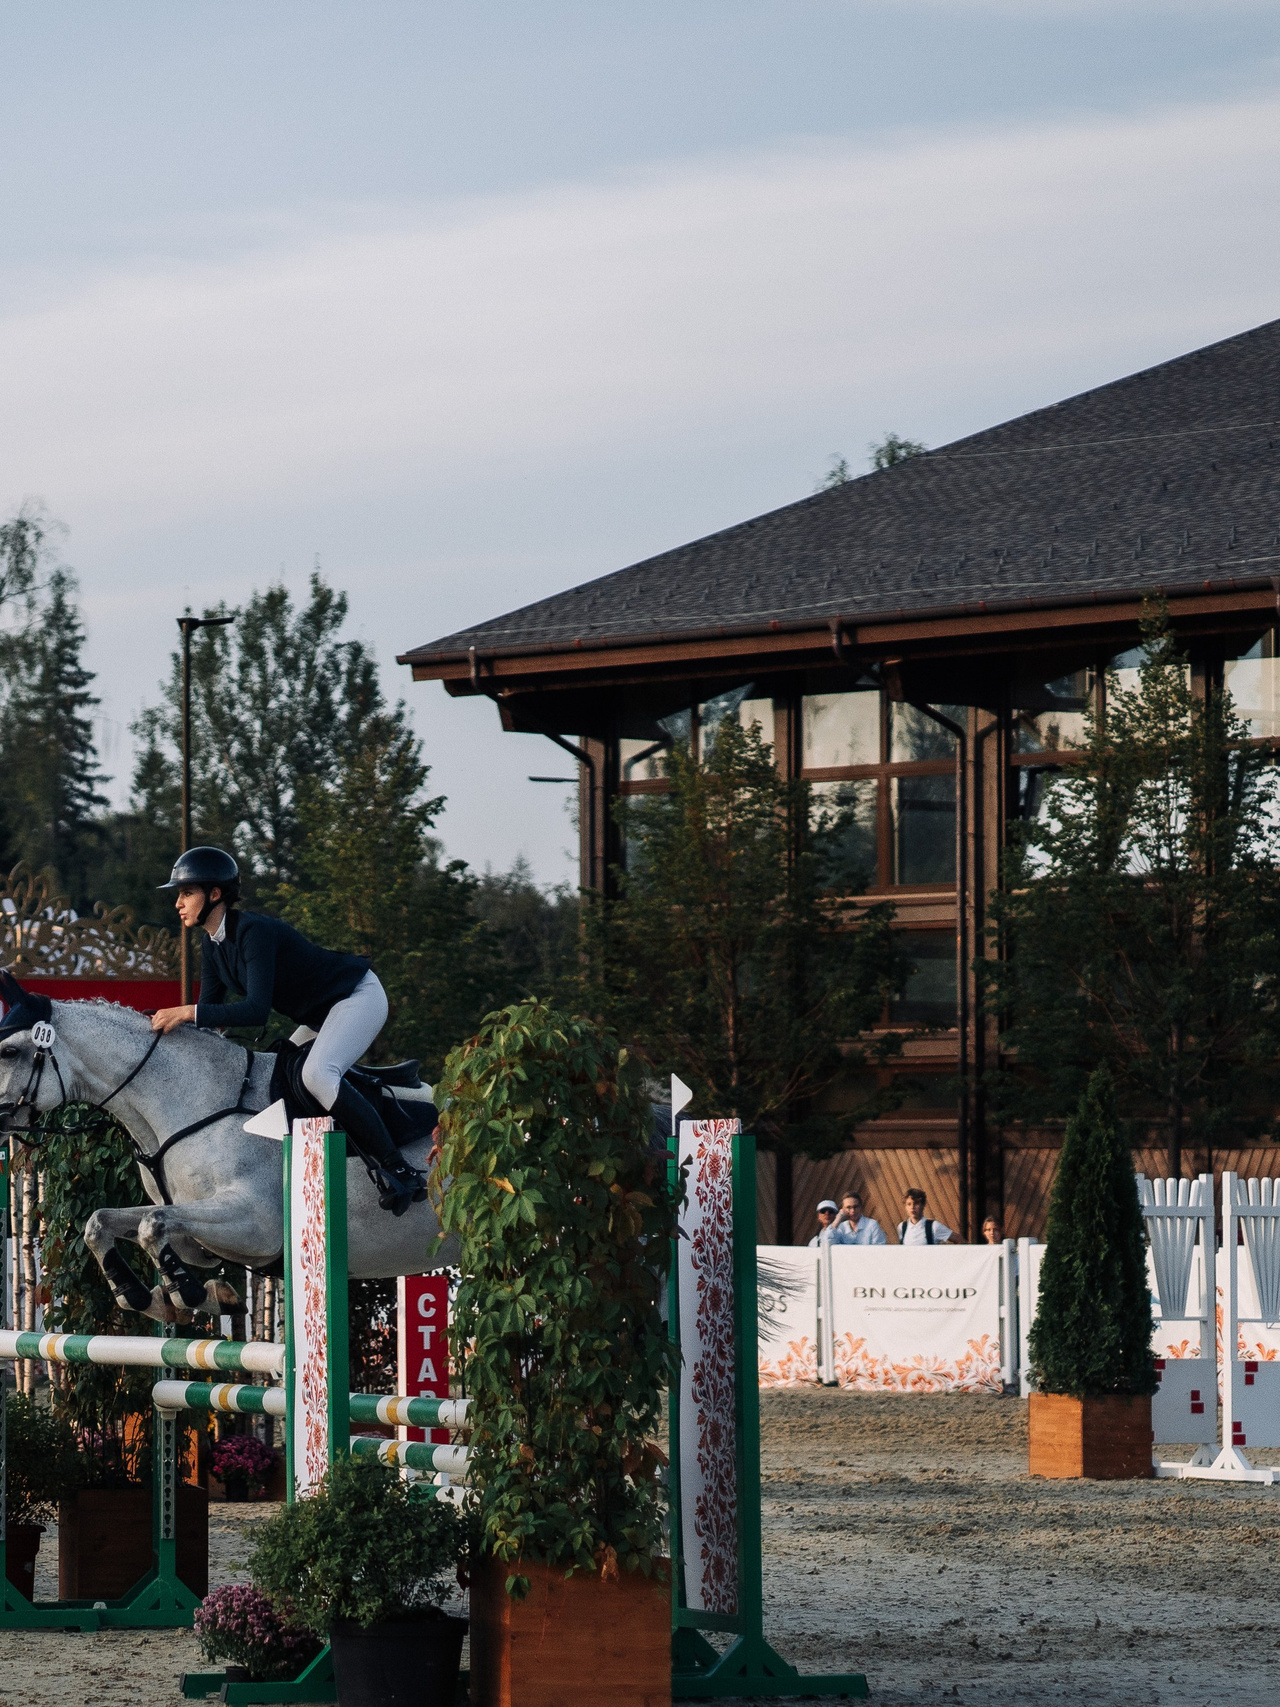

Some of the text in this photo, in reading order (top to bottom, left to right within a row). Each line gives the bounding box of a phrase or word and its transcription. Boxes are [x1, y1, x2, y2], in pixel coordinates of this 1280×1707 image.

[34, 1026, 52, 1043] 038
[853, 1287, 977, 1299] BN GROUP
